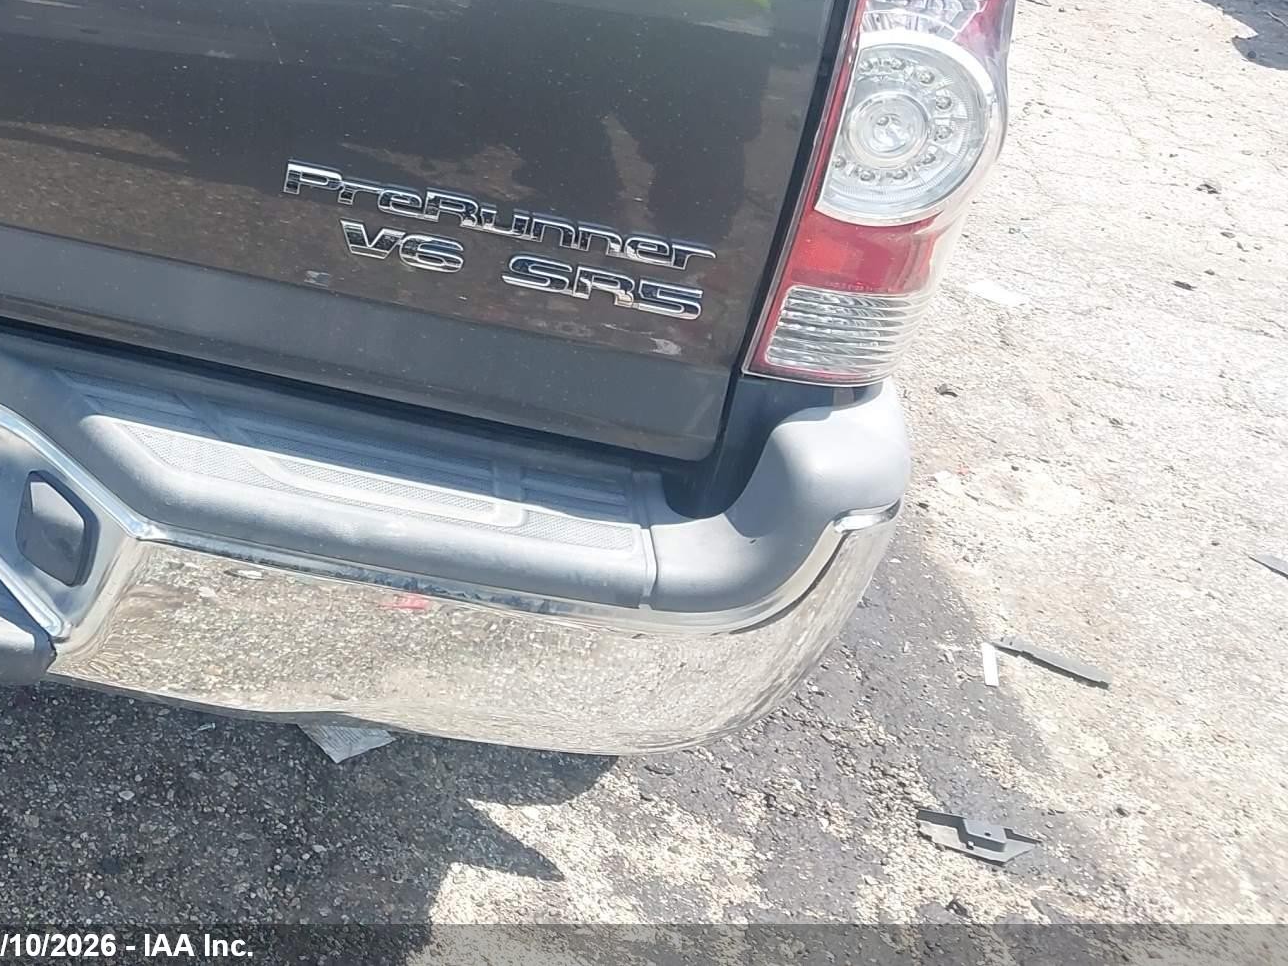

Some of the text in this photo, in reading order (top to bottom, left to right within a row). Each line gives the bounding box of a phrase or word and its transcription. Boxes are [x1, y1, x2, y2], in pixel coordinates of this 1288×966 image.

[283, 158, 717, 270] PreRunner
[339, 218, 704, 321] V6 SR5
